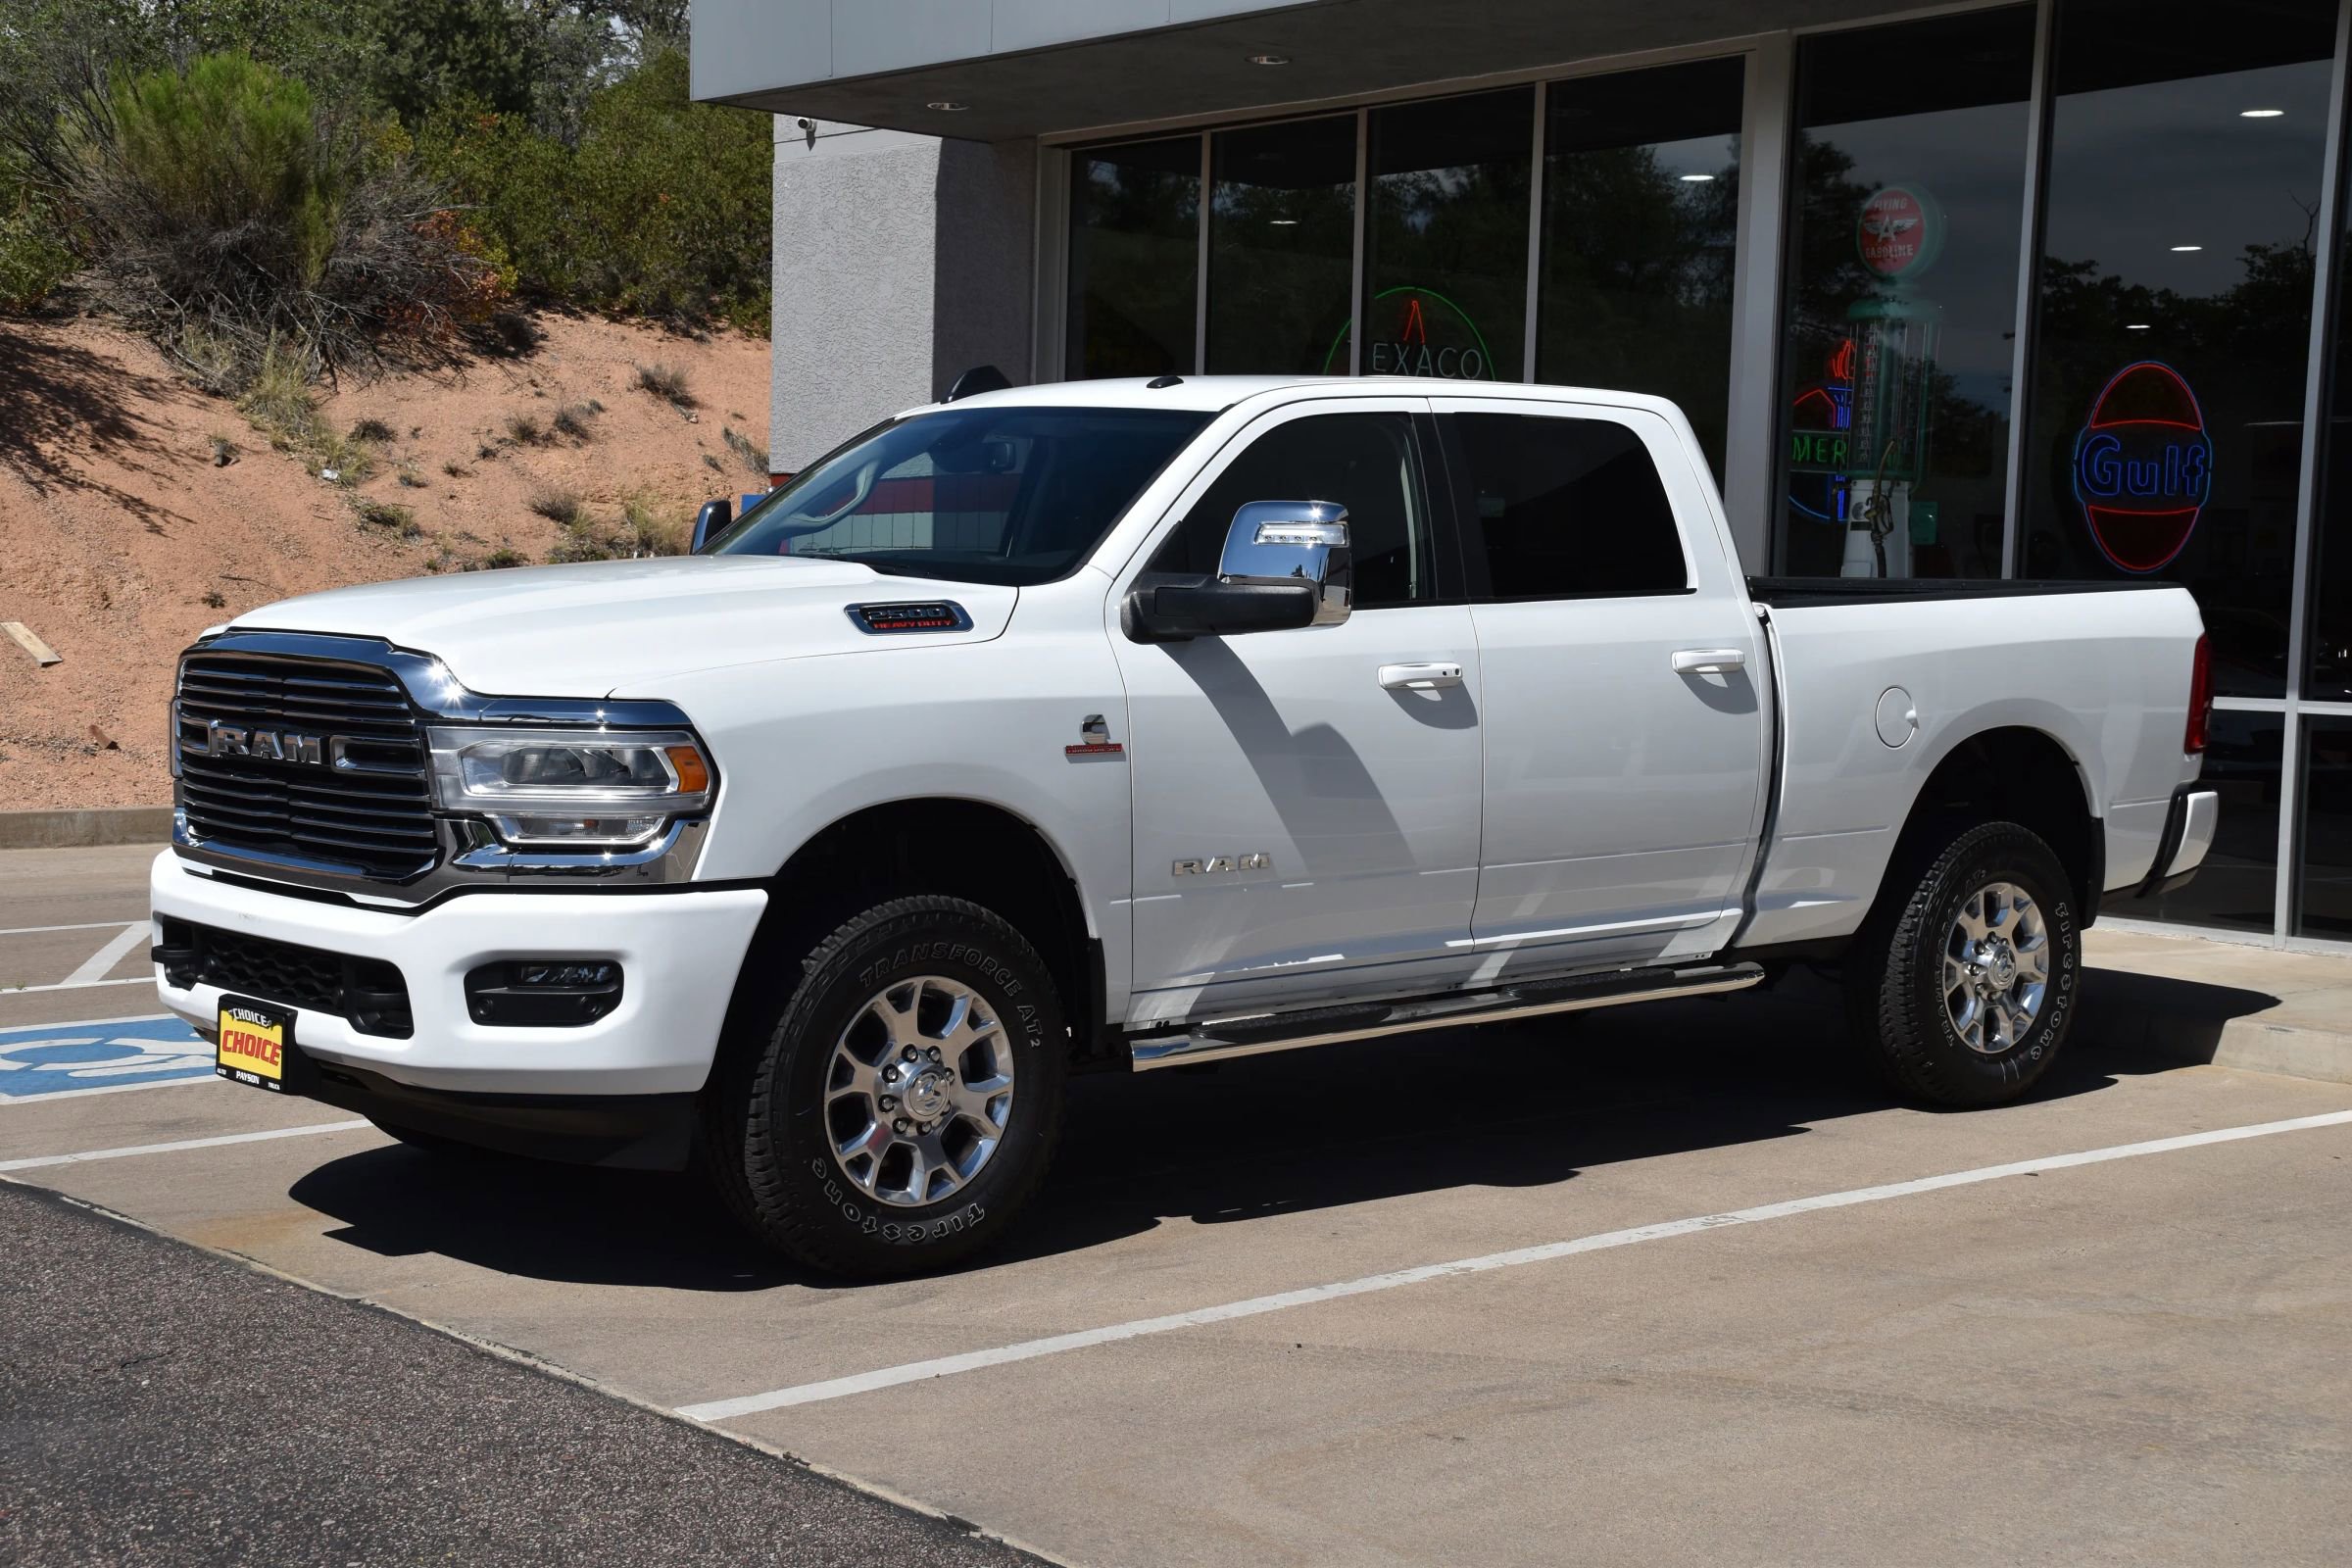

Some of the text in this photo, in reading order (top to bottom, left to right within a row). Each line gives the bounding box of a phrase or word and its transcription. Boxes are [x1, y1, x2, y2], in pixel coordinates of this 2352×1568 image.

[1873, 197, 1907, 212] FLYING
[1865, 244, 1914, 259] GASOLINE
[1348, 338, 1483, 380] EXACO
[2080, 433, 2206, 497] Gulf
[867, 608, 947, 621] 2500
[873, 620, 915, 629] HEAVY
[217, 725, 322, 765] RAM
[1172, 853, 1271, 877] RAM
[858, 941, 1024, 998] TRANSFORCE
[2031, 902, 2074, 1060] Firestone
[233, 1007, 268, 1027] CHOICE
[221, 1029, 283, 1066] CHOICE
[235, 1070, 260, 1085] PAYSON
[811, 1156, 985, 1242] Firestone
